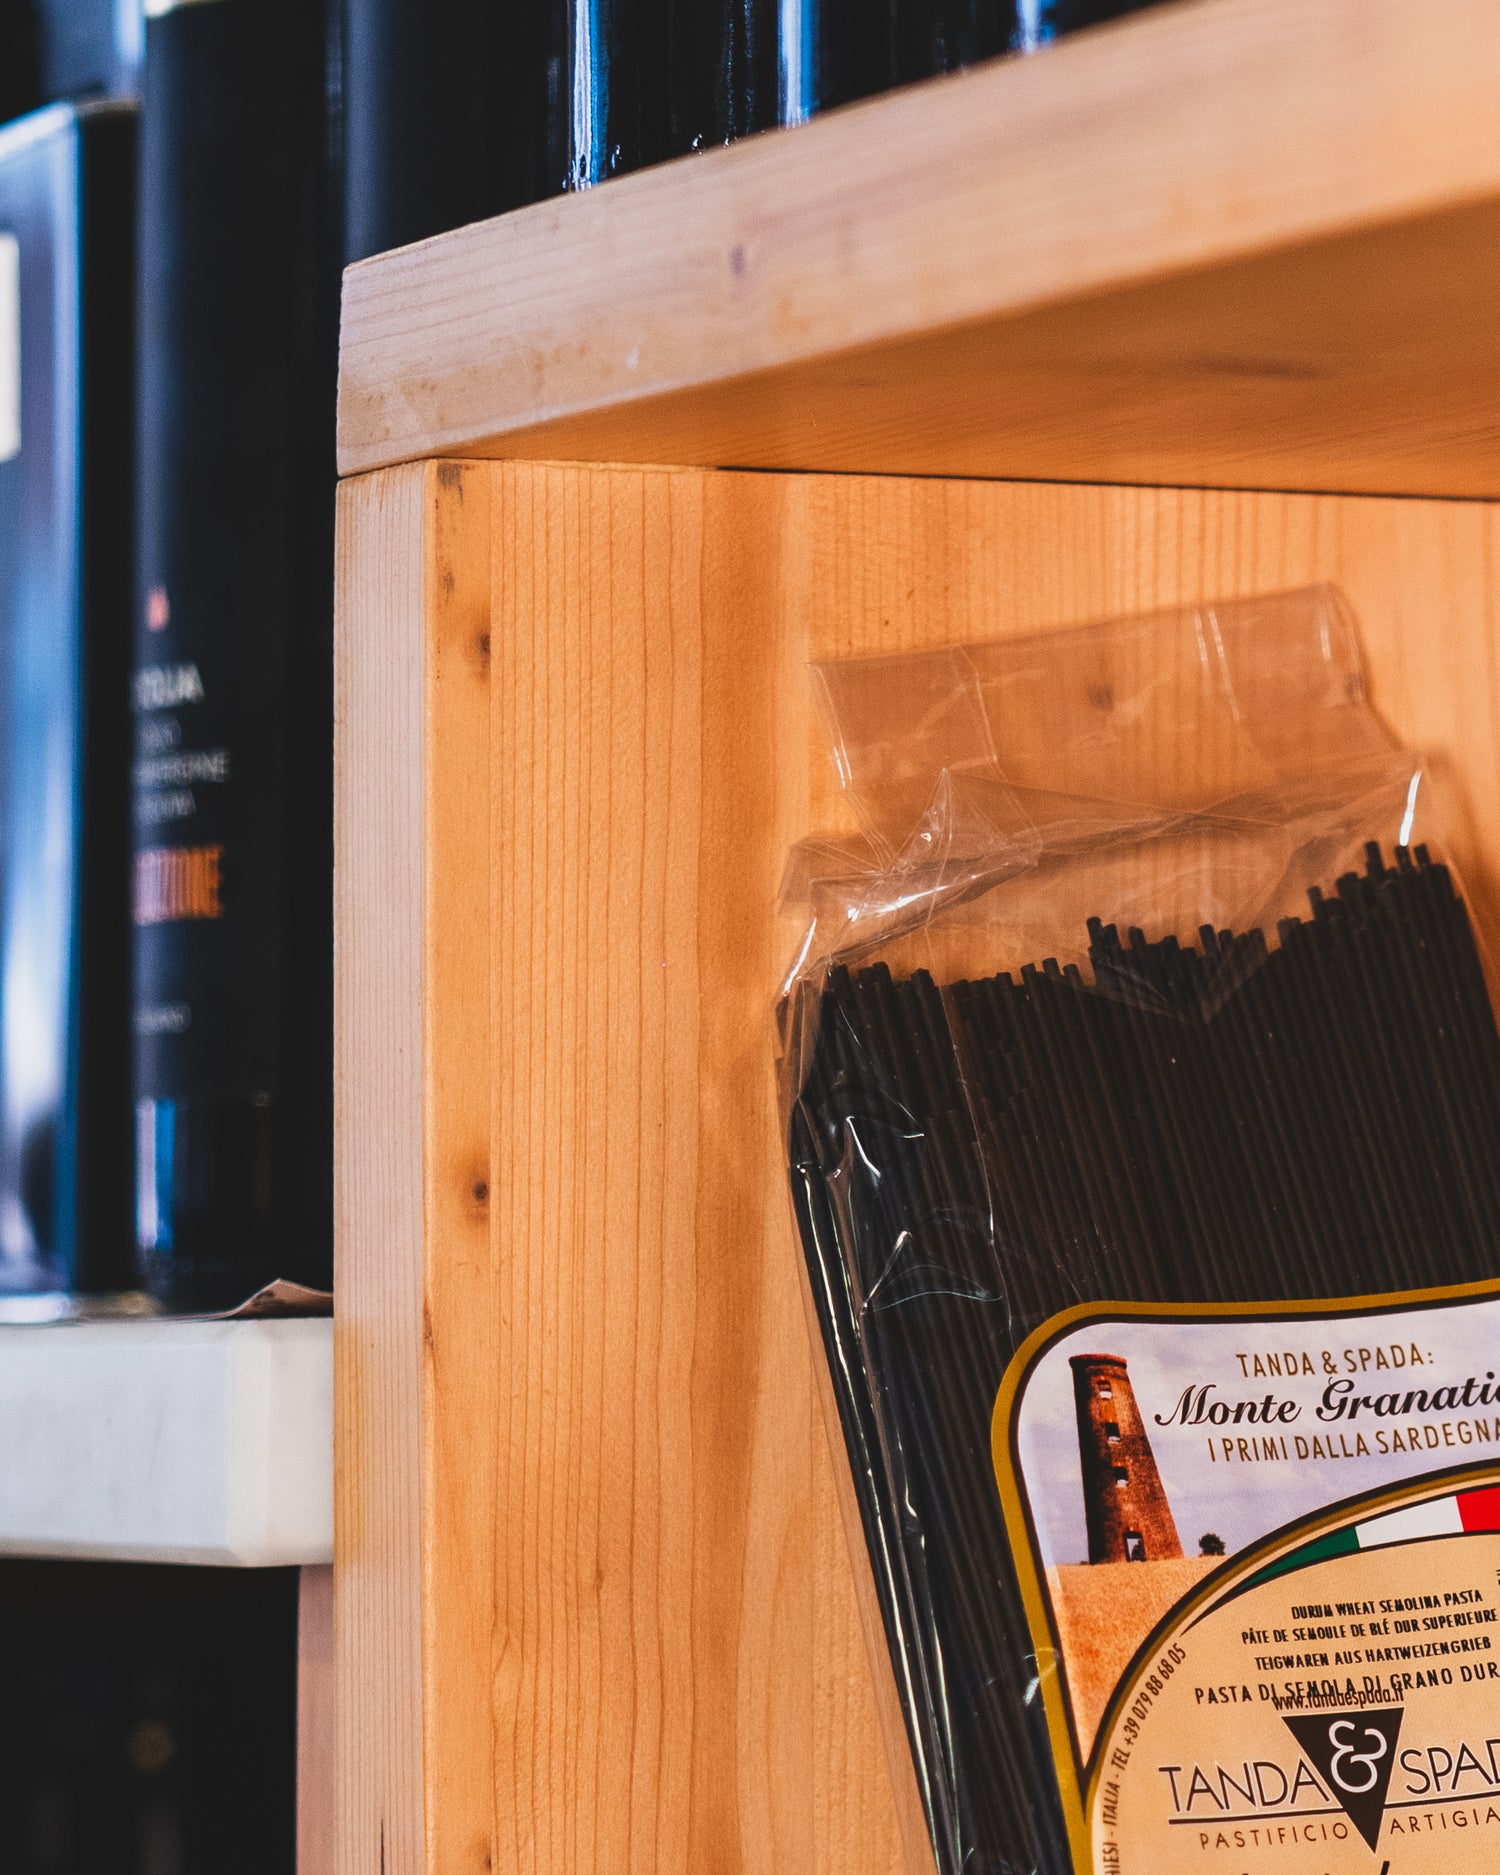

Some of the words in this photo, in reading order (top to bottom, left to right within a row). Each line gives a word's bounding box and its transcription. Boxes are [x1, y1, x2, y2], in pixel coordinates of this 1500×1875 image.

[1235, 1352, 1315, 1378] TANDA
[1321, 1351, 1338, 1375] &
[1344, 1343, 1434, 1373] SPADA:
[1153, 1384, 1303, 1425] Monte
[1207, 1438, 1217, 1462] I
[1221, 1436, 1288, 1462] PRIMI
[1294, 1433, 1370, 1460] DALLA
[1291, 1604, 1334, 1620] DURUM
[1335, 1601, 1376, 1616] WHEAT
[1379, 1595, 1441, 1613] SEMOLINA
[1444, 1590, 1483, 1606] PASTA
[1242, 1627, 1270, 1644] PÂTE
[1273, 1629, 1289, 1643] DE
[1292, 1624, 1346, 1641] SEMOULE
[1350, 1623, 1366, 1637] DE
[1370, 1618, 1391, 1635] BLÉ
[1394, 1619, 1421, 1634] DUR
[1422, 1609, 1499, 1630] SUPERIEURE
[1168, 1642, 1186, 1665] 05
[1254, 1653, 1329, 1670] TEIGWAREN
[1334, 1650, 1363, 1665] AUS
[1365, 1636, 1491, 1661] HARTWEIZENGRIEB
[1157, 1658, 1175, 1680] 68
[1144, 1674, 1164, 1697] 88
[1194, 1685, 1252, 1704] PASTA
[1258, 1684, 1277, 1701] DI
[1285, 1678, 1357, 1700] SEMOLA
[1362, 1675, 1382, 1693] DI
[1390, 1668, 1453, 1691] GRANO
[1131, 1691, 1154, 1720] 079
[1123, 1717, 1145, 1746] +39
[1111, 1745, 1131, 1770] TEL
[1158, 1757, 1331, 1812] TANDA
[1328, 1720, 1387, 1793] &
[1102, 1780, 1121, 1826] ITALIA
[1199, 1822, 1348, 1850] PASTIFICIO
